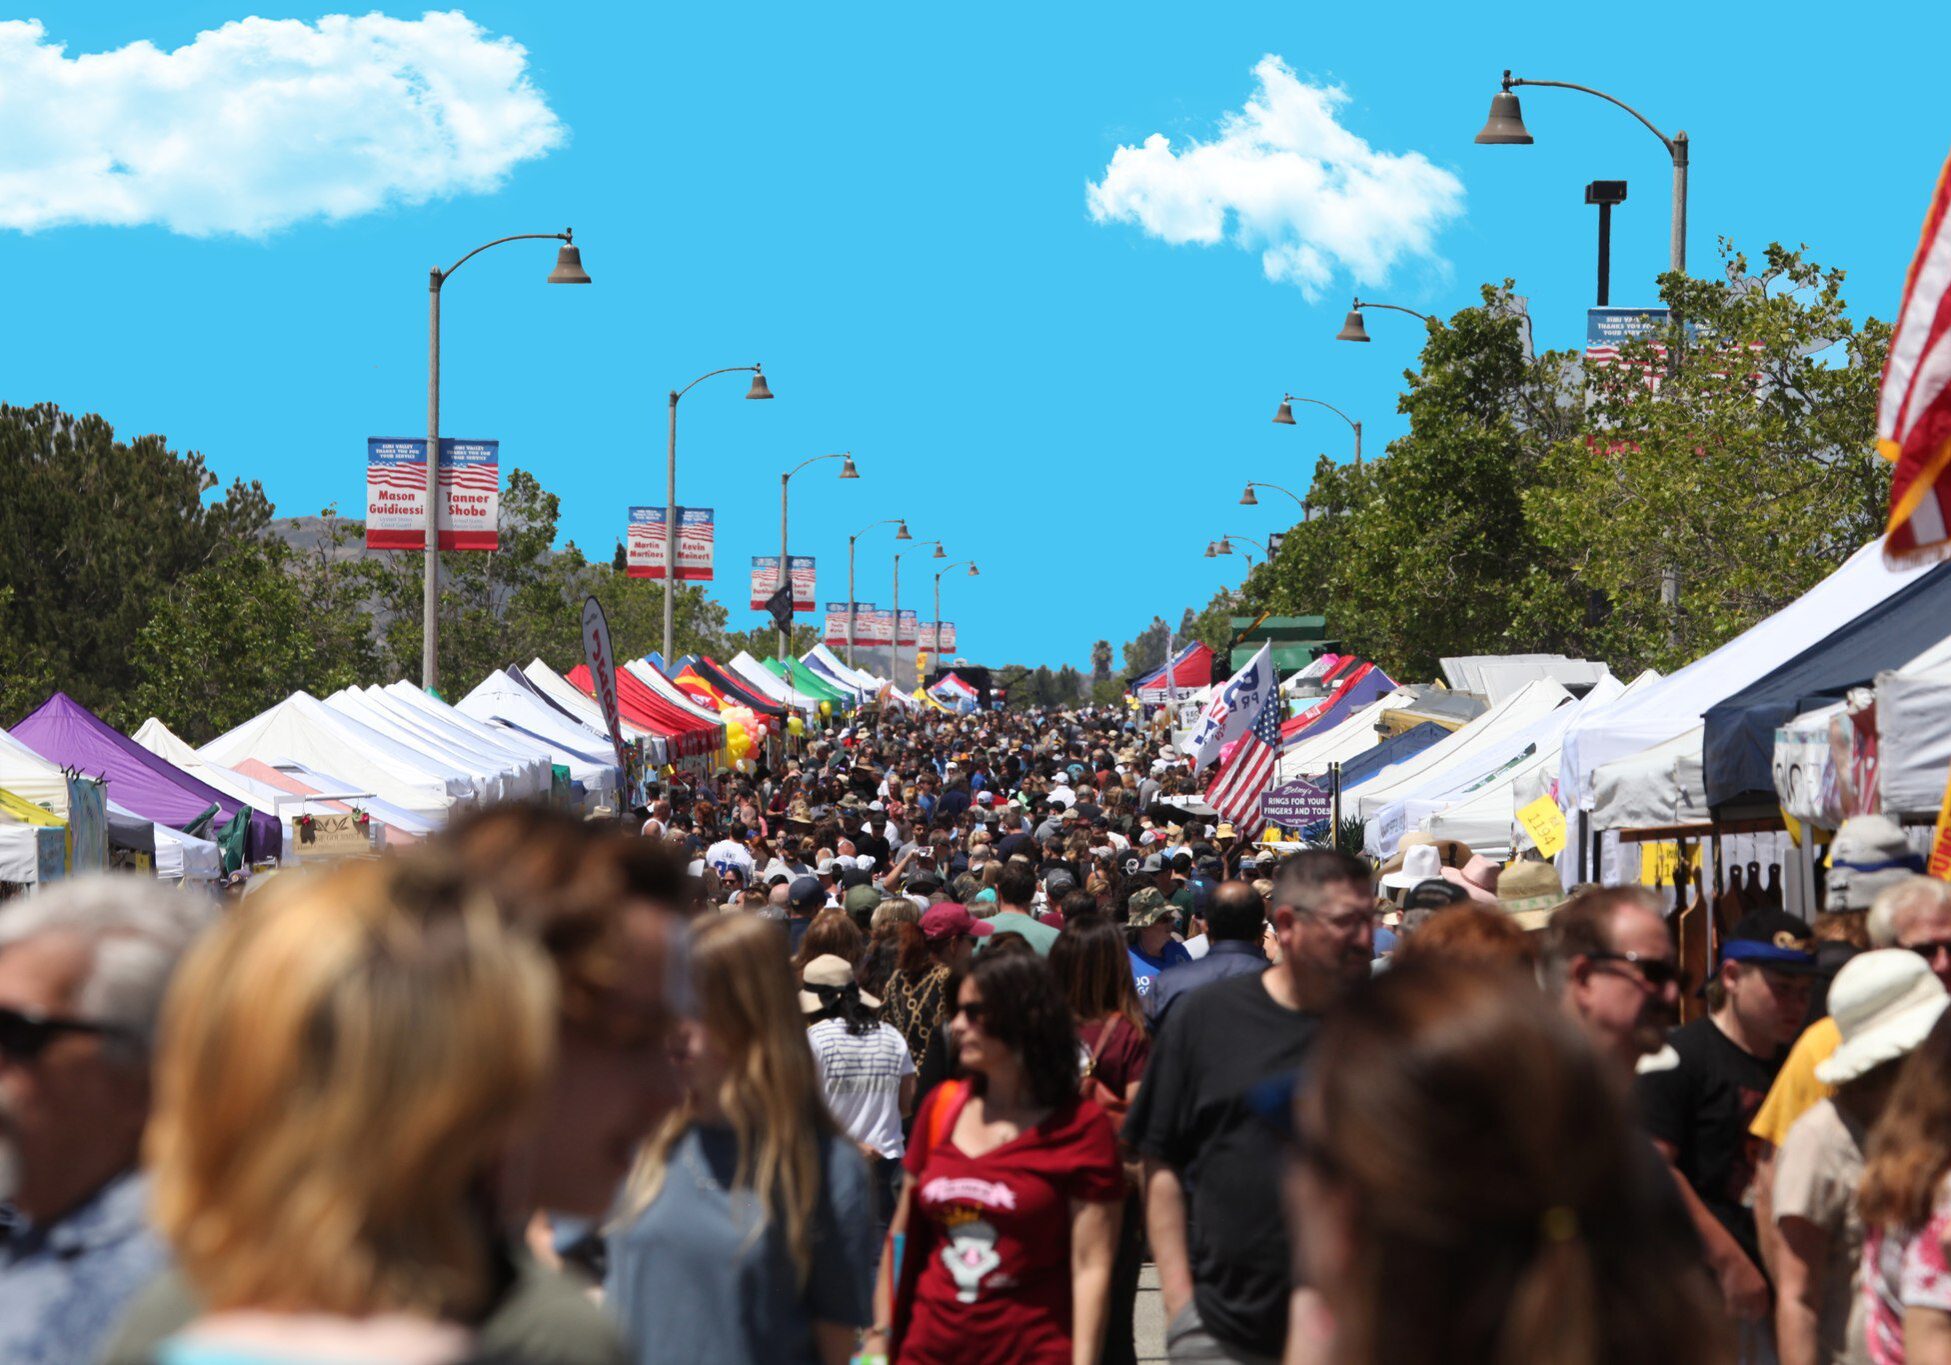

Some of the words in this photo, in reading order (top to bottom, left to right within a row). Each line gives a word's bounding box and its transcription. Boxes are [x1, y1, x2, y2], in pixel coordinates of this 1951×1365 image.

[379, 490, 415, 501] Mason
[446, 492, 489, 503] Tanner
[369, 504, 424, 515] Guidicessi
[448, 505, 487, 516] Shobe
[682, 542, 705, 551] Kevin
[1268, 797, 1289, 805] RINGS
[1291, 797, 1305, 805] FOR
[1264, 807, 1293, 815] FINGERS
